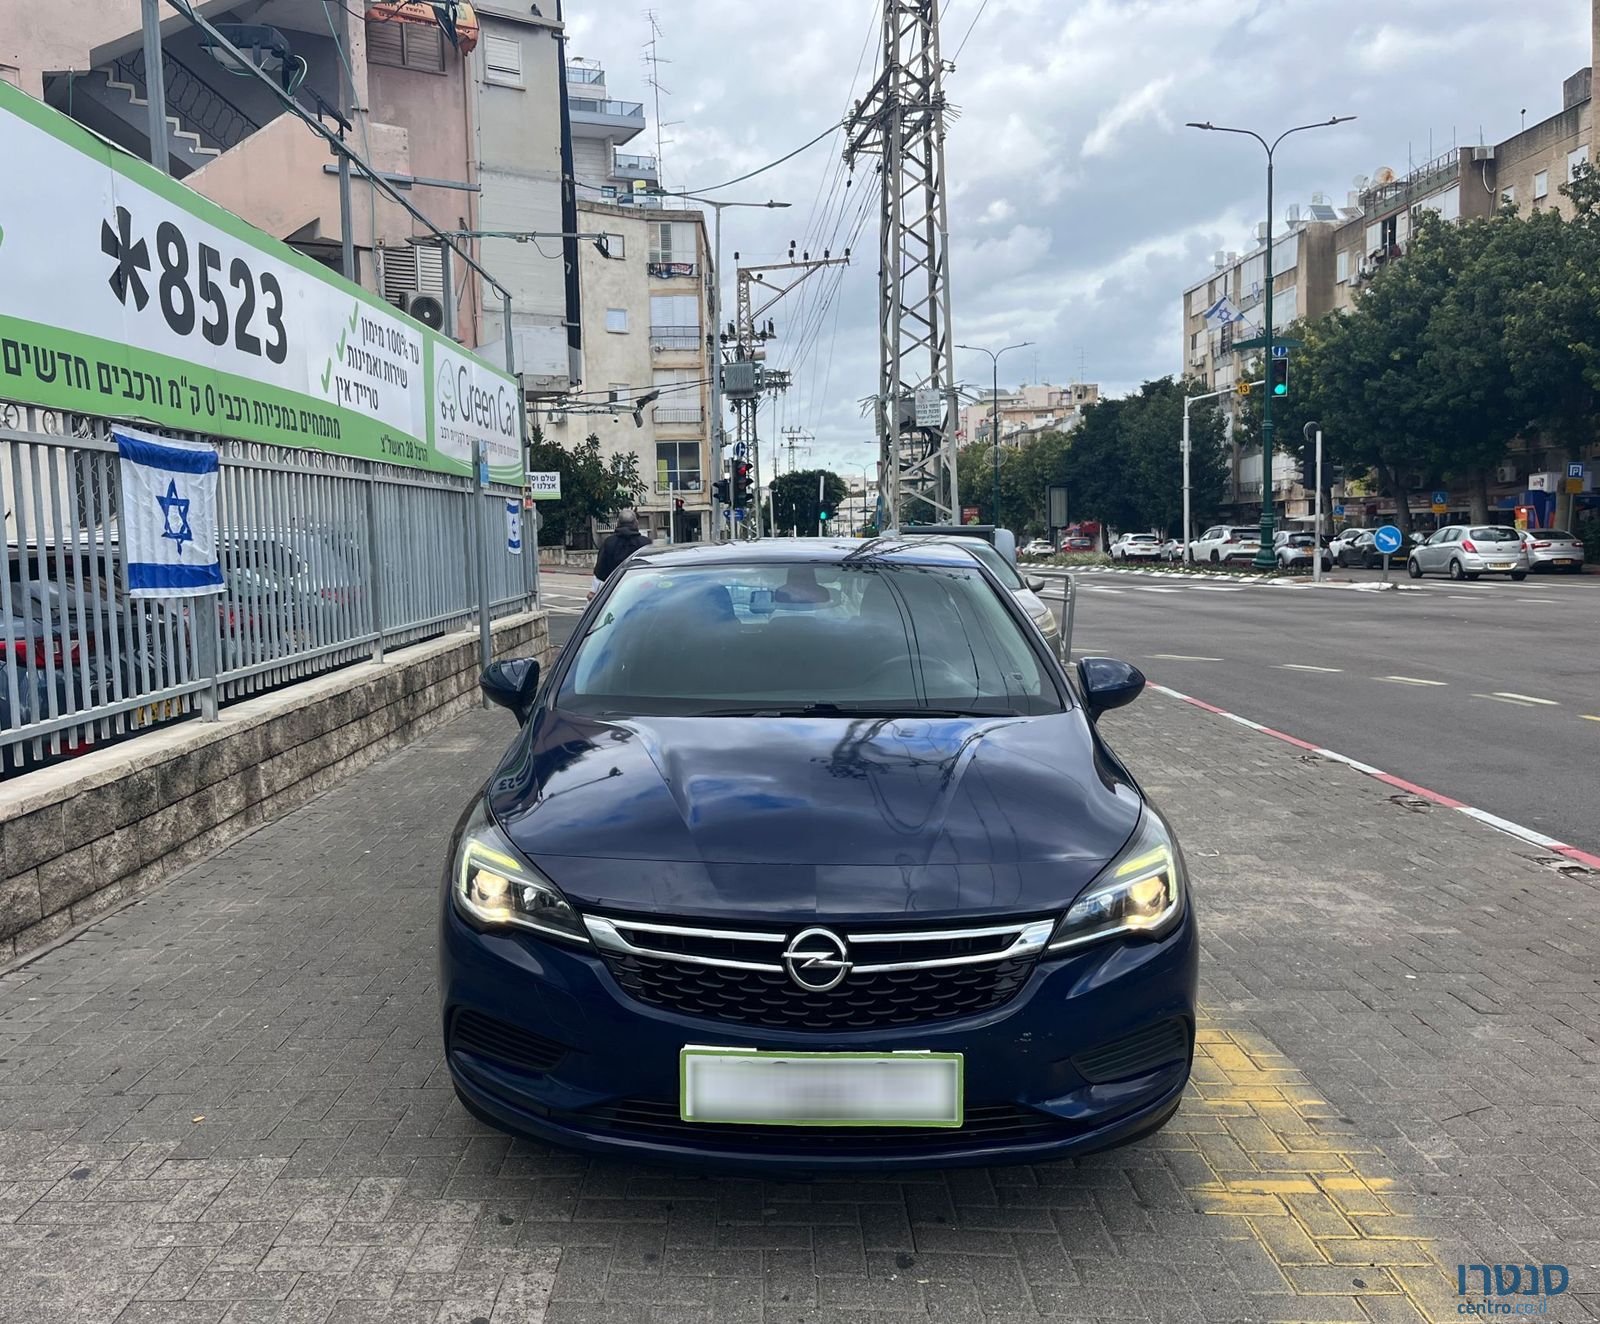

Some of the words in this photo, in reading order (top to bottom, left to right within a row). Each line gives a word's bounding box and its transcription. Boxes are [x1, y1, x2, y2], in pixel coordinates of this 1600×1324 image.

[361, 316, 385, 348] מימון
[386, 327, 409, 360] 100%
[1, 338, 91, 391] חדשים
[346, 344, 382, 379] ואמינות
[408, 342, 420, 365] עד
[96, 361, 163, 406] ורכבים
[383, 360, 408, 389] שירות
[1239, 384, 1248, 393] 13
[205, 383, 215, 416] 0
[335, 375, 352, 407] אין
[353, 381, 379, 410] טרייד
[458, 365, 497, 432] Green
[498, 385, 516, 438] Car
[218, 392, 251, 424] רכבי
[253, 400, 298, 432] במכירת
[300, 409, 341, 440] מתמחים
[406, 440, 414, 459] 28
